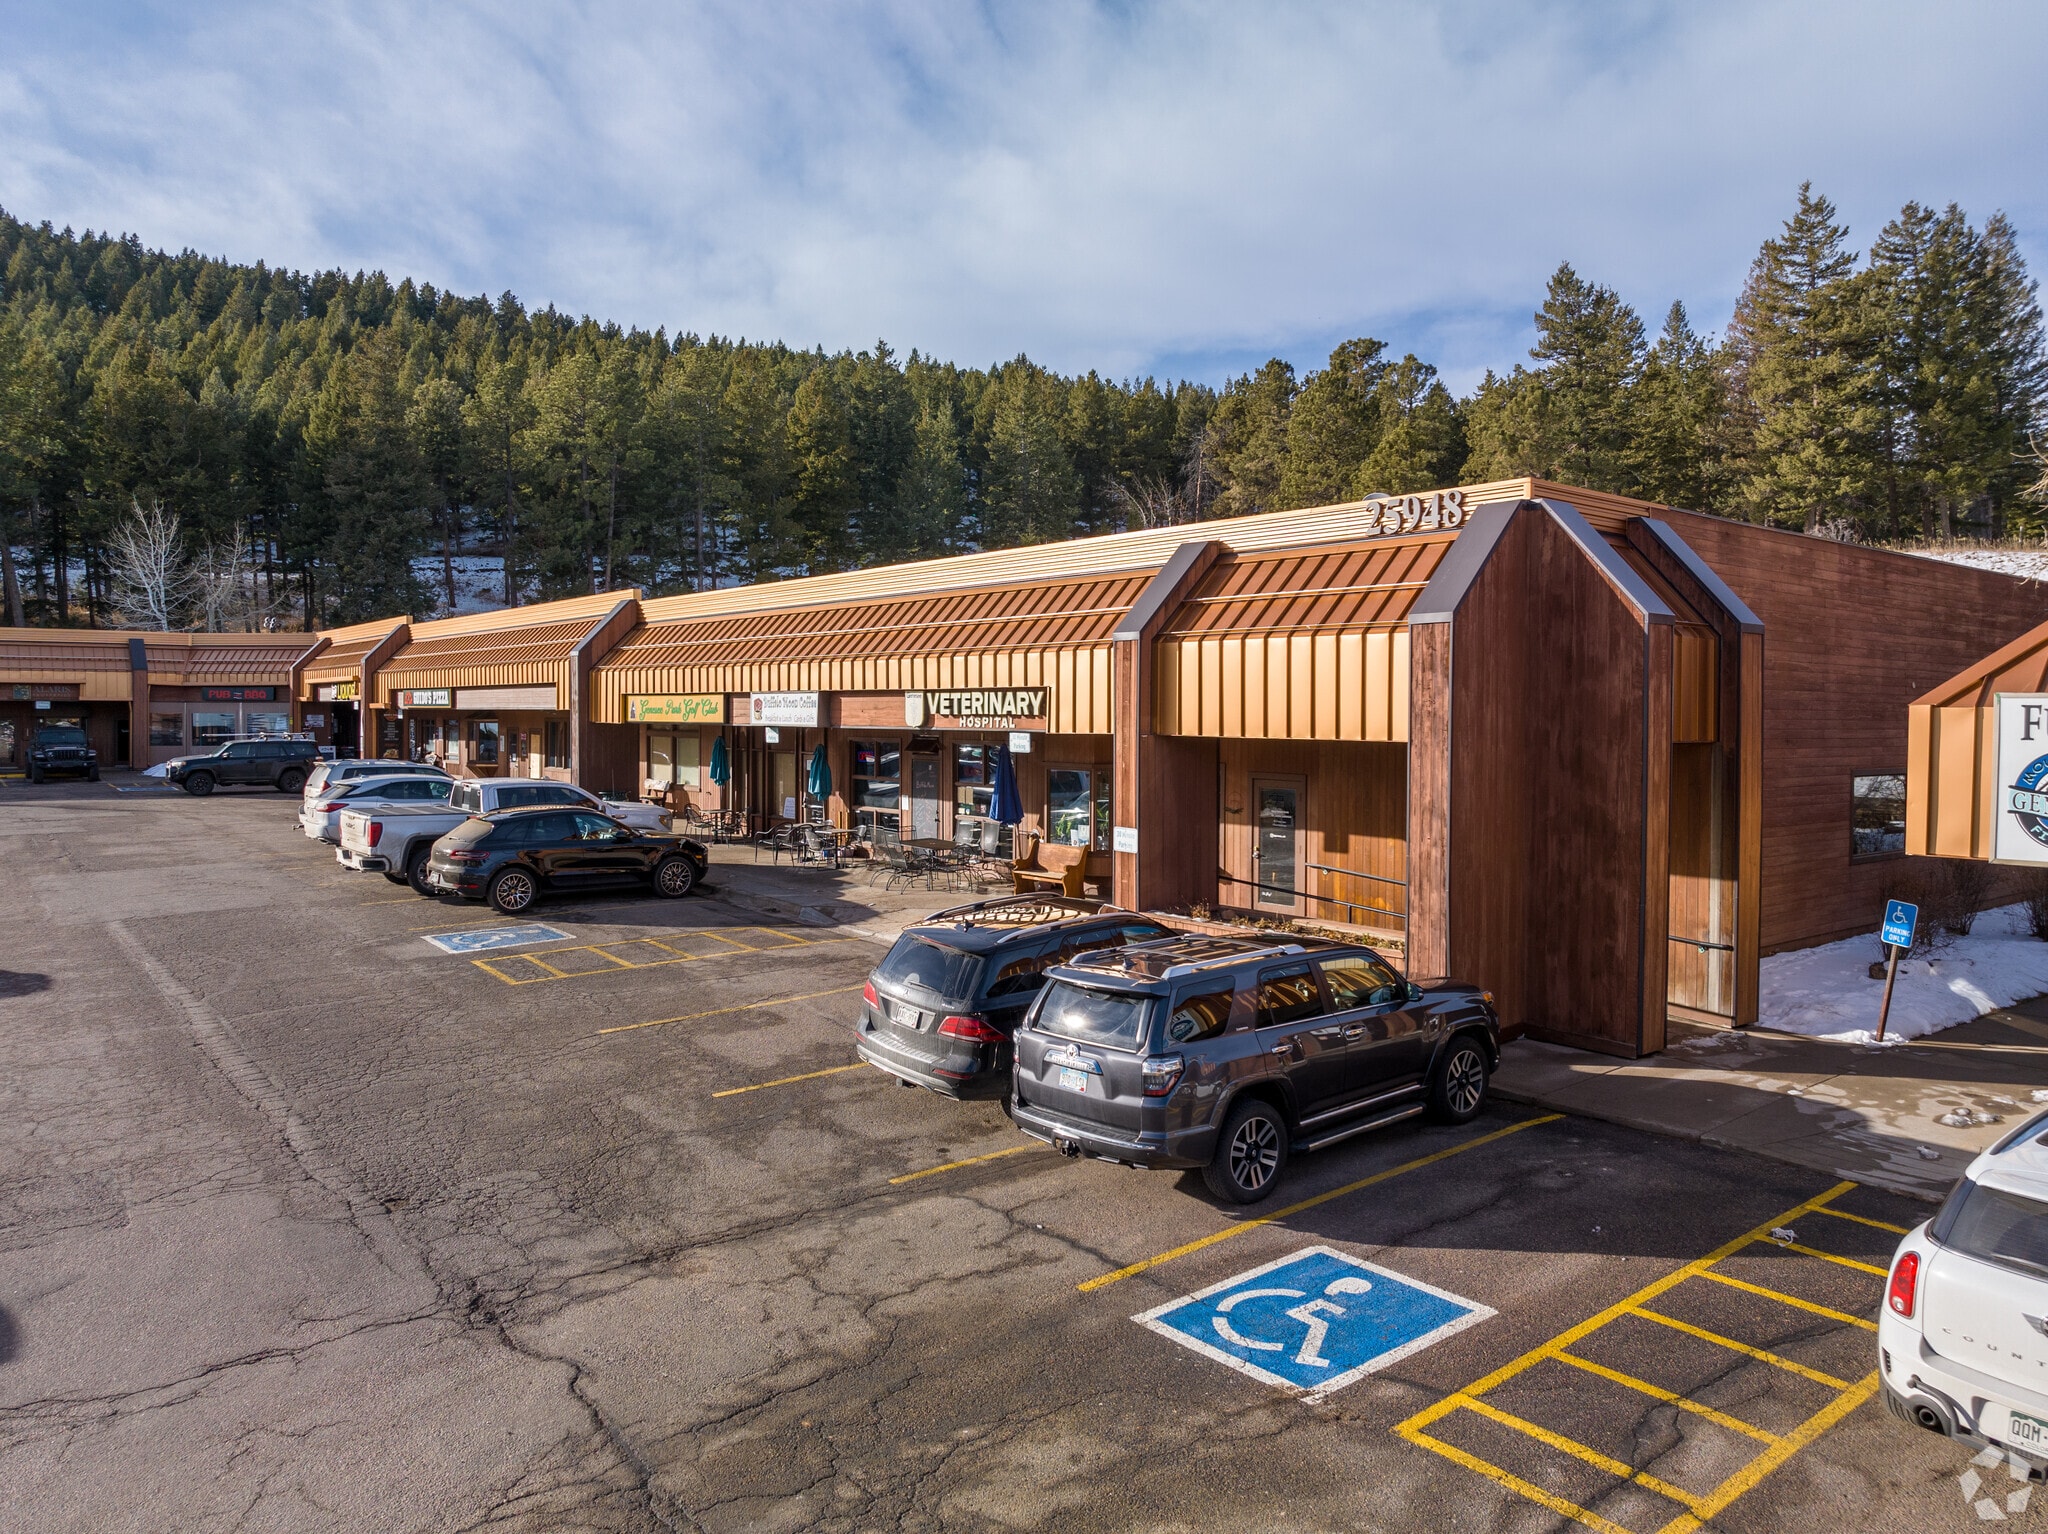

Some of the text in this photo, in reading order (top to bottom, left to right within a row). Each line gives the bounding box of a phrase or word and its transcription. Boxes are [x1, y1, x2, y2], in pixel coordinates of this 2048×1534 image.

[1365, 489, 1464, 537] 25948
[208, 689, 231, 699] PUB
[244, 689, 267, 700] BBQ
[432, 690, 449, 705] PIZZA
[701, 698, 718, 716] Club
[926, 690, 1044, 716] VETERINARY
[959, 715, 1016, 729] HOSPITAL
[1885, 925, 1912, 938] PARKING
[1888, 933, 1906, 943] ONLY
